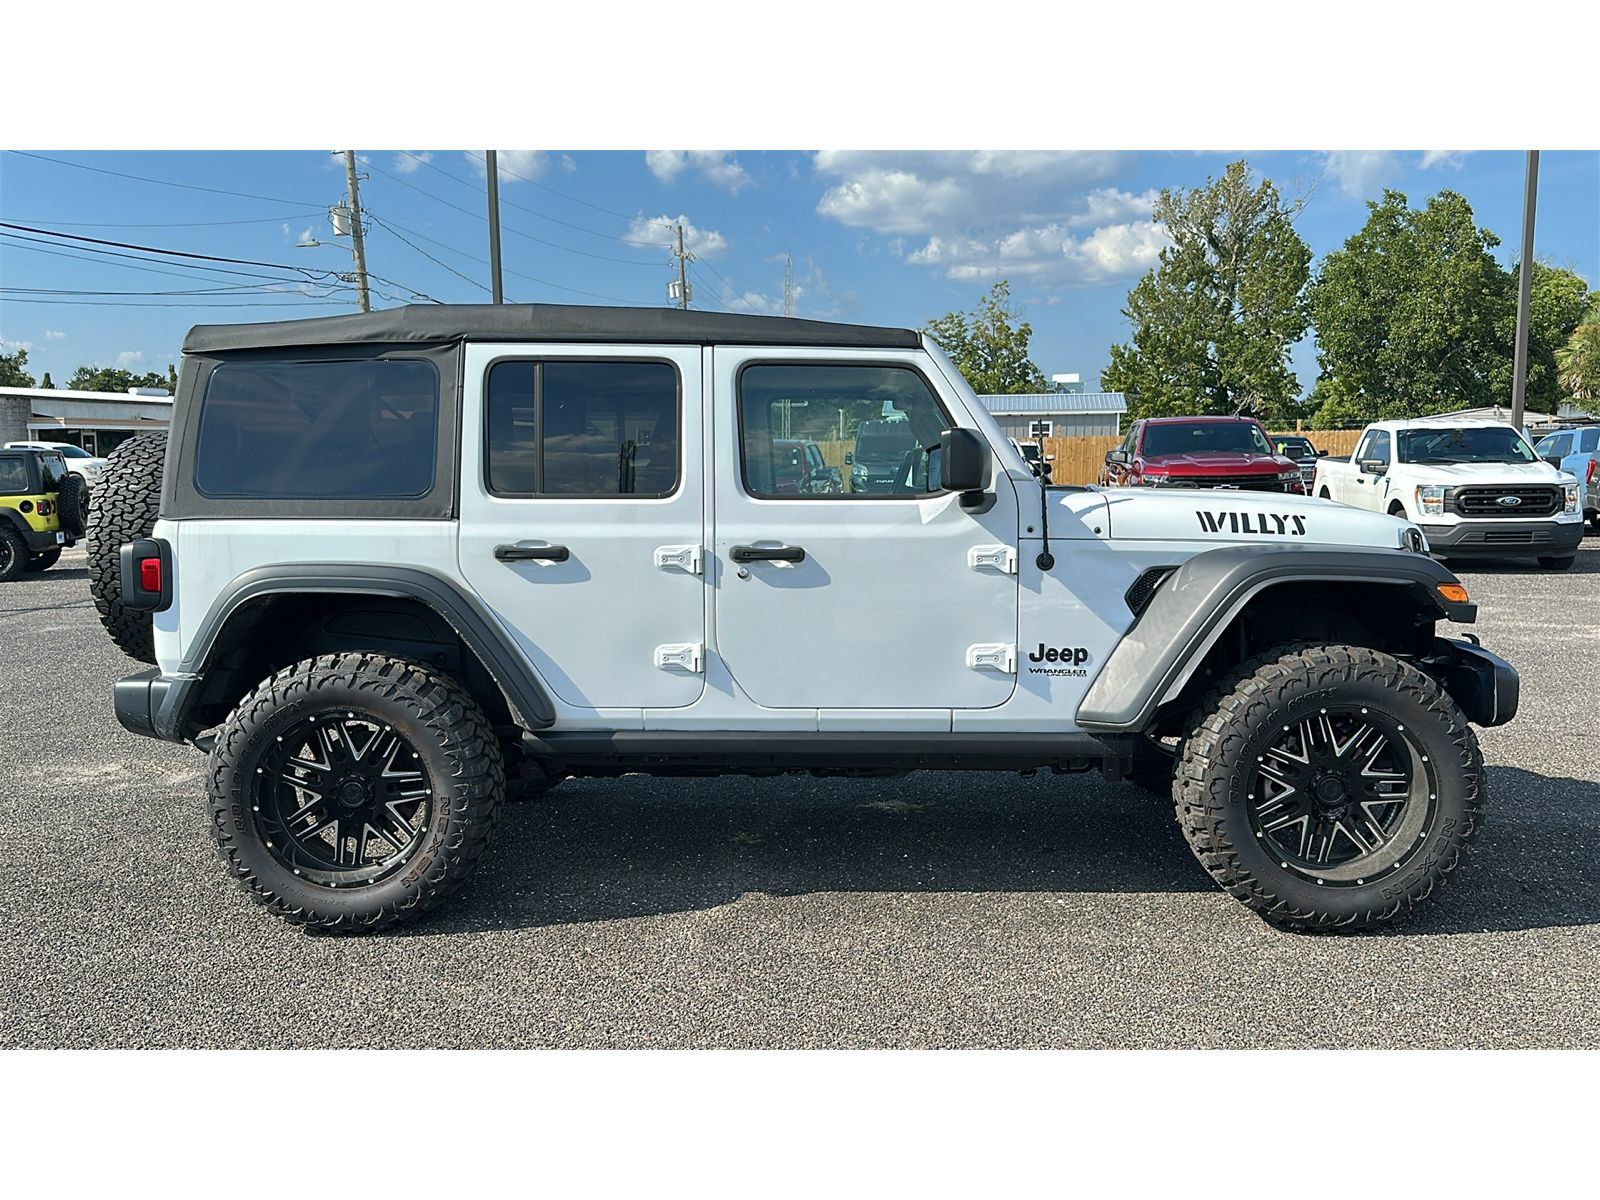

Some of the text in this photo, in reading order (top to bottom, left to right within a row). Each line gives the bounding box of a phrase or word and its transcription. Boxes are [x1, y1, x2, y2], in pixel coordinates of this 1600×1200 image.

[1195, 511, 1306, 535] WILLYS
[1029, 643, 1088, 666] Jeep
[400, 796, 450, 889] NEXEN
[1381, 816, 1457, 900] NEXEN
